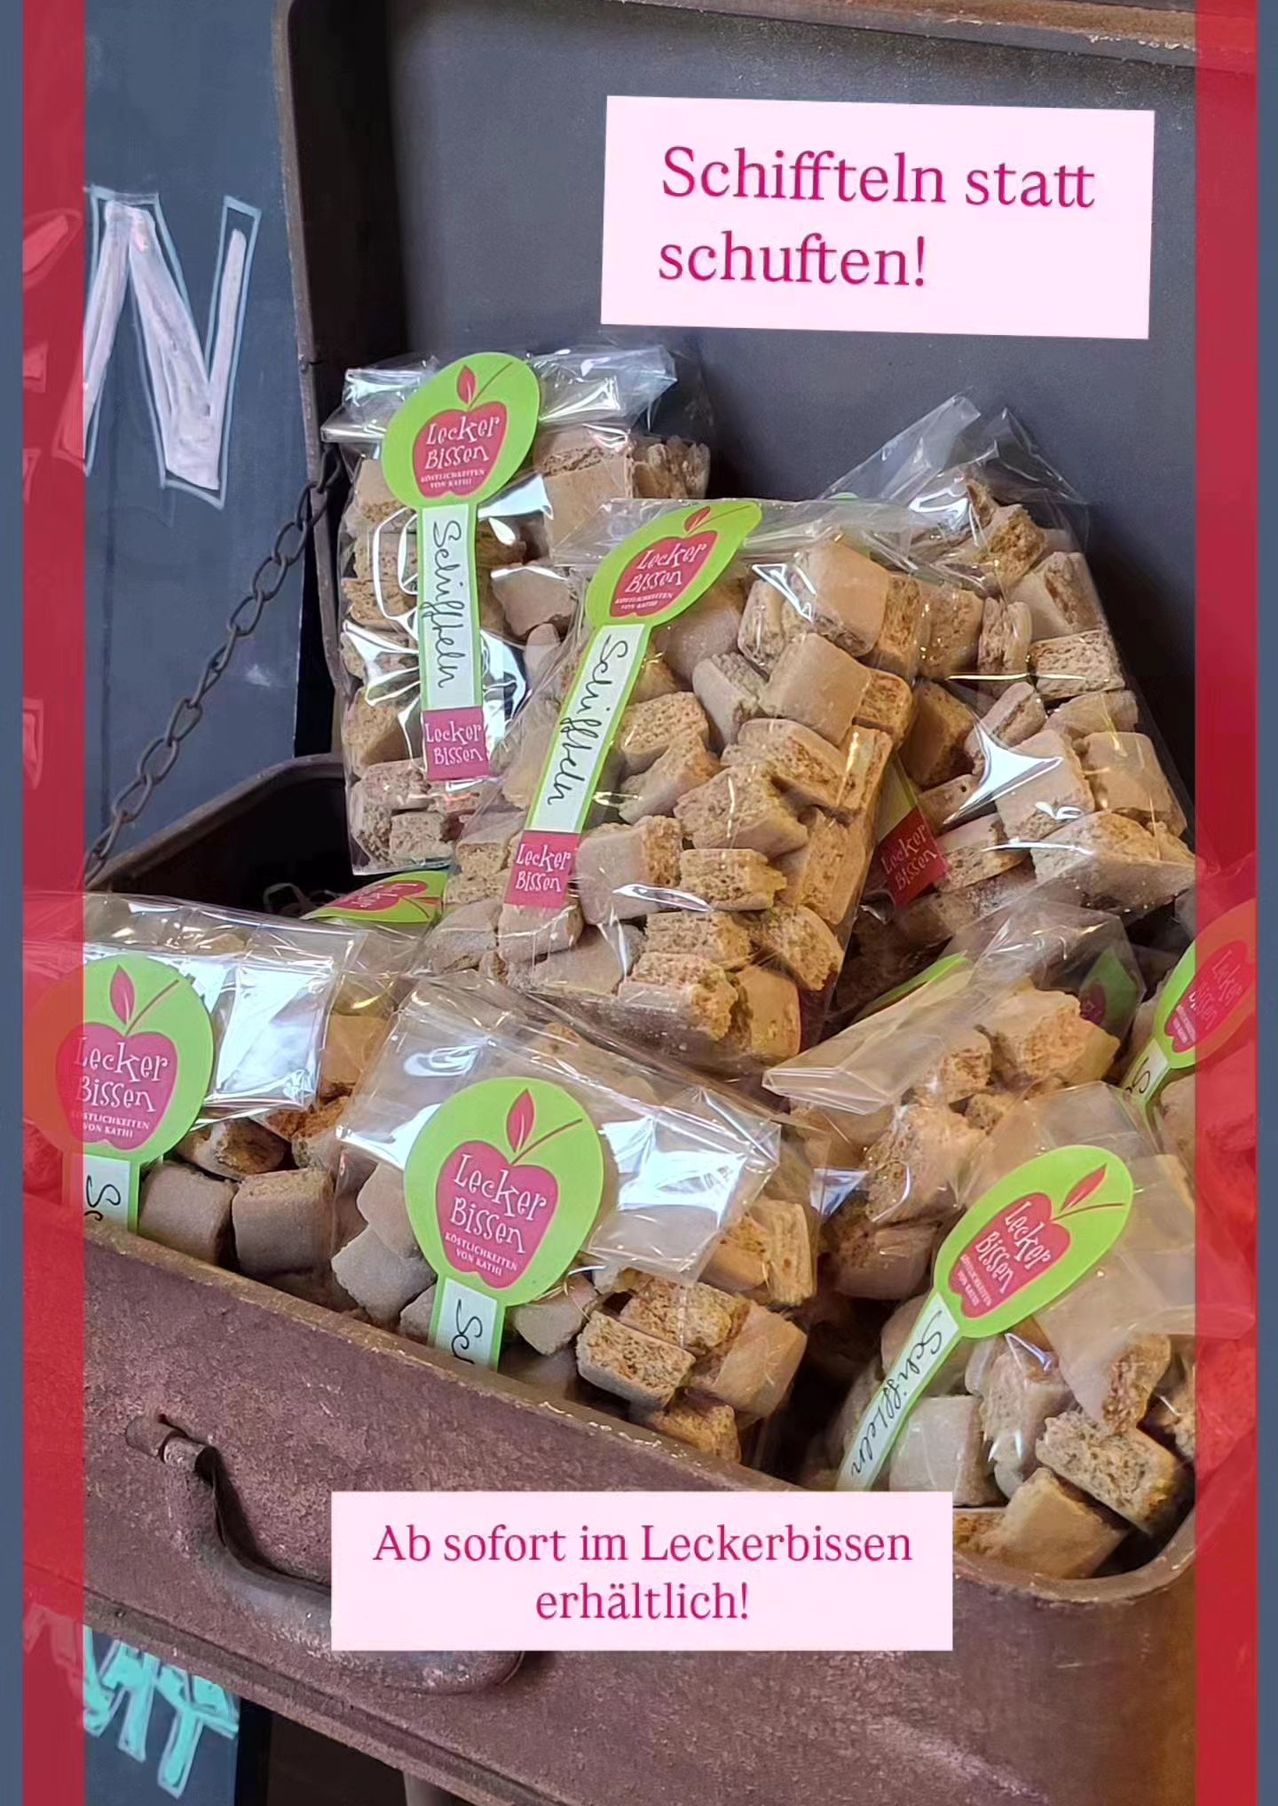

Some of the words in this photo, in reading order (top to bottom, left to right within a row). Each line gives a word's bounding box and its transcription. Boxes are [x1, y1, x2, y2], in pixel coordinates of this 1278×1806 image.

[425, 415, 500, 446] Lecker
[424, 446, 490, 470] Bissen
[636, 542, 708, 571] Lecker
[624, 569, 683, 594] Bissen
[424, 719, 482, 746] Lecker
[433, 746, 485, 767] Bissen
[515, 842, 572, 874] Lecker
[515, 869, 562, 894] Bissen
[72, 1034, 169, 1083] Lecker
[74, 1075, 156, 1113] Bissen
[453, 1152, 548, 1222] Lecker
[449, 1196, 527, 1255] Bissen
[1004, 1200, 1052, 1271] Lecker
[974, 1230, 1014, 1295] Bissen
